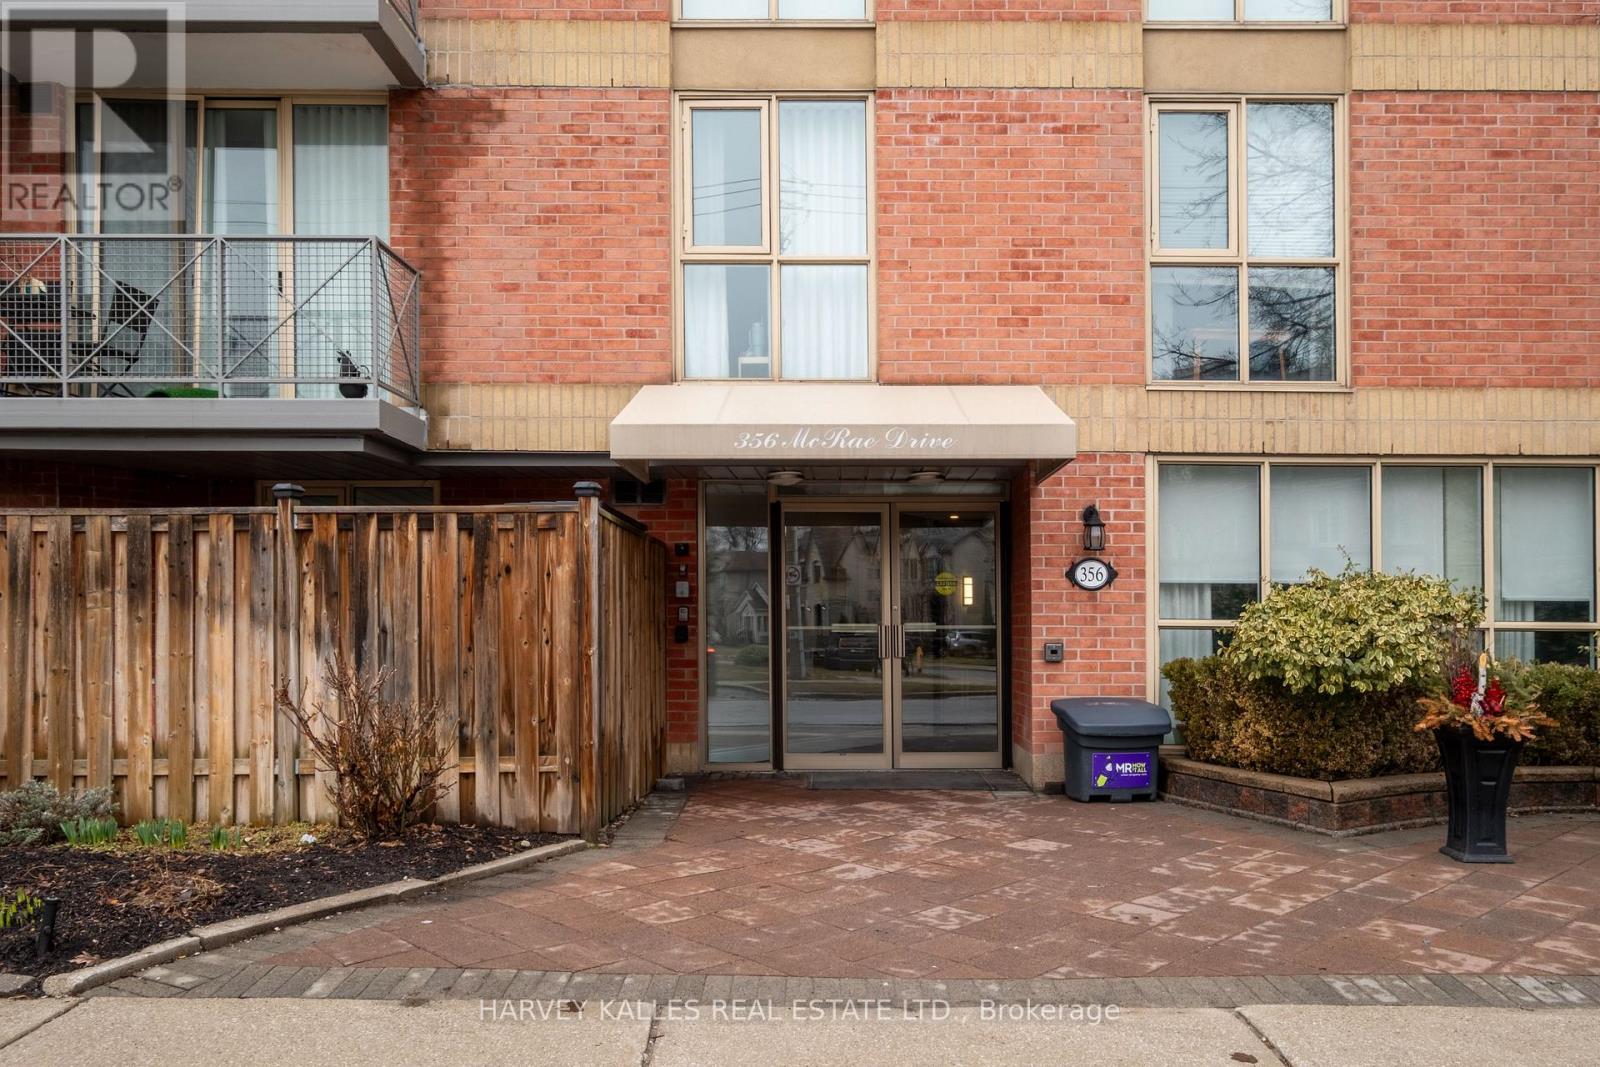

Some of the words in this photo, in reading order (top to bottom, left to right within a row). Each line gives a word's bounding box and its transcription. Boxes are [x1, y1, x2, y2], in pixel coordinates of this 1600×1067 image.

[734, 432, 780, 449] 356
[782, 427, 877, 449] McRae
[885, 426, 955, 449] Drive
[1080, 566, 1104, 582] 356
[1116, 762, 1132, 773] MR
